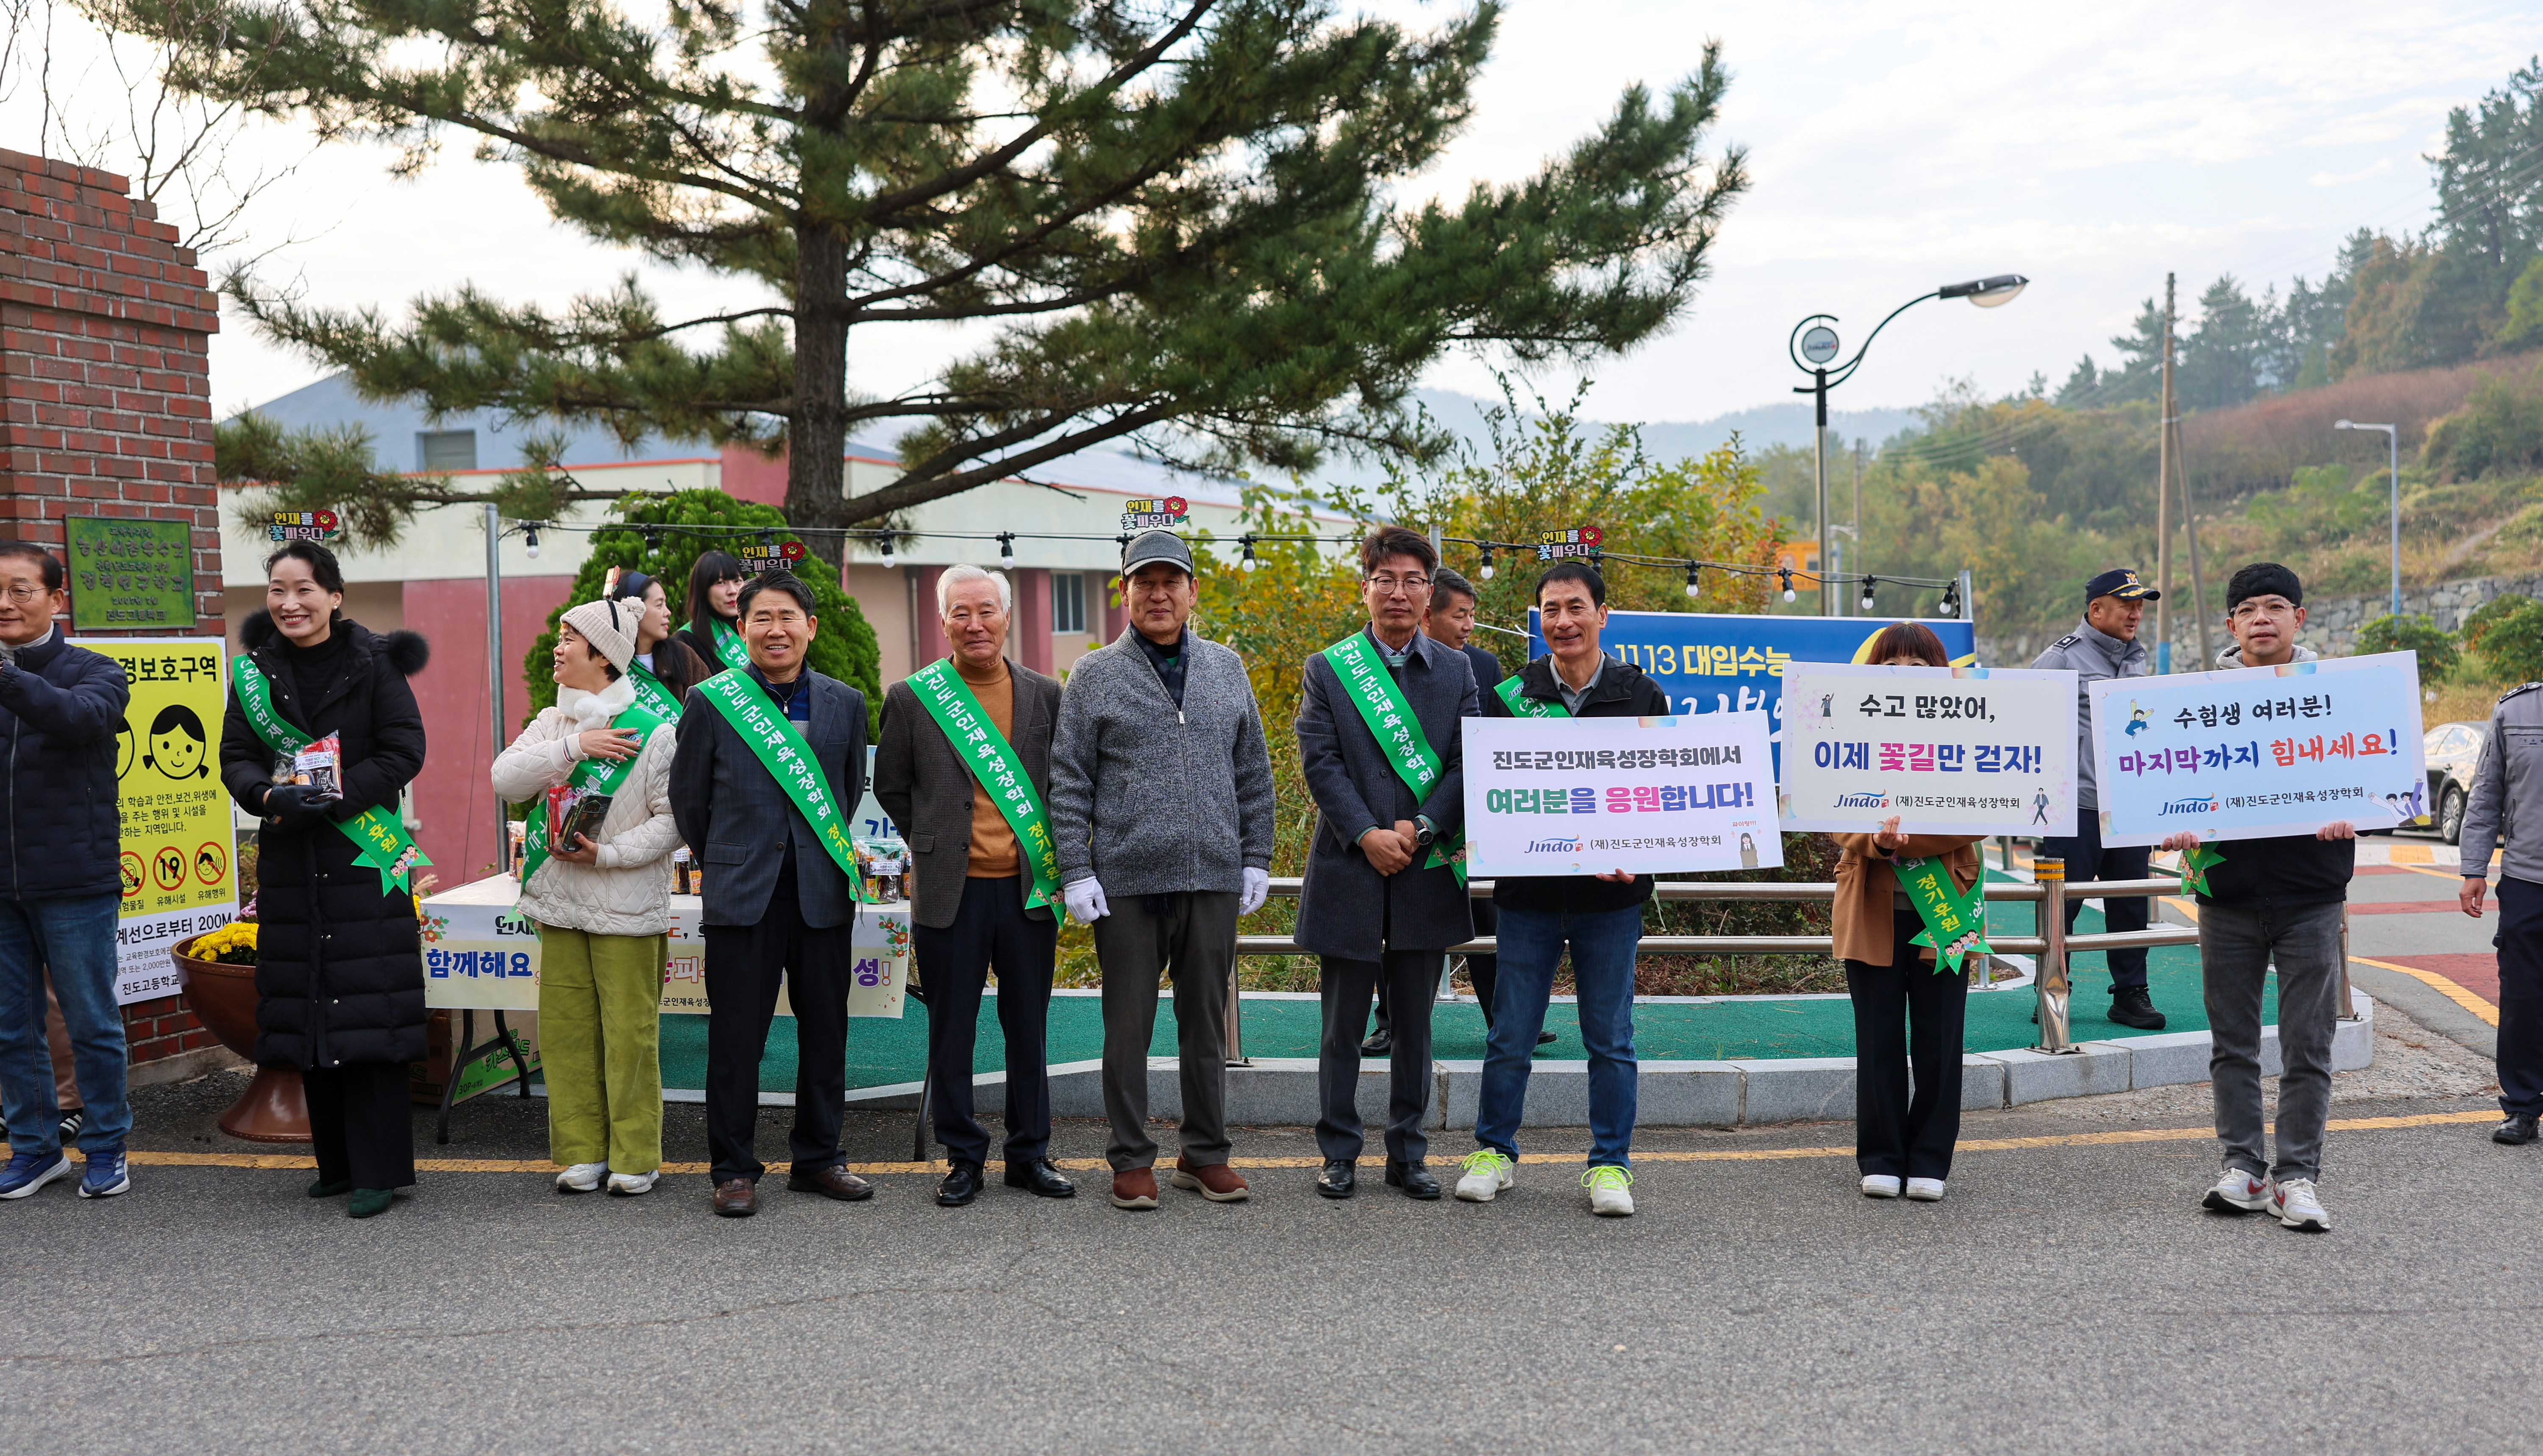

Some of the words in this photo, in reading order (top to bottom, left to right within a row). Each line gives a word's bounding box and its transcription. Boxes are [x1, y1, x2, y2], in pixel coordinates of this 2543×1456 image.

[1127, 500, 1164, 513] 인재를
[274, 512, 313, 525] 인재를
[1122, 514, 1174, 529] 꽃피우다
[270, 525, 324, 541] 꽃피우다
[1542, 530, 1579, 544] 인재를
[743, 545, 781, 559] 인재를
[1537, 544, 1589, 560] 꽃피우다
[739, 558, 792, 572] 꽃피우다
[81, 572, 184, 592] 정책연구학교
[107, 609, 166, 621] 진도고등학교
[1683, 645, 1792, 677] 대입수능
[1333, 640, 1435, 785] (재)진도군인재육성장학회
[1859, 695, 1906, 717] 수고
[1915, 696, 1995, 723] 많았어,
[2173, 702, 2240, 729] 수험생
[2252, 694, 2332, 722] 여러분!
[708, 673, 831, 820] (재)진도군인재육성장학회
[915, 665, 1034, 818] (재)진도군인재육성장학회
[1493, 746, 1741, 770] 진도군인재육성장학회에서
[1814, 742, 1869, 770] 이제
[1878, 742, 1965, 772] 꽃길만
[1974, 745, 2041, 774] 걷자!
[2119, 740, 2260, 778] 마지막까지
[2270, 728, 2397, 767] 힘내세요!
[128, 795, 153, 807] 학습과
[1486, 788, 1597, 814] 여러분을
[1605, 782, 1754, 813] 응원합니다!
[1833, 794, 1880, 809] Jindo
[1895, 795, 2020, 809] (재)진도군인재육성장학회
[2158, 800, 2208, 817] Jindo
[2226, 786, 2364, 809] (재)진도군인재육성장학회
[132, 811, 148, 822] 주는
[153, 808, 169, 820] 행위
[173, 807, 180, 818] 및
[184, 804, 206, 817] 시설을
[145, 821, 186, 836] 지역입니다.
[1525, 839, 1574, 853] Jindo
[1590, 835, 1722, 850] (재)진도군인재육성장학회
[159, 856, 180, 880] 19
[157, 893, 186, 906] 유해시설
[198, 887, 225, 900] 유해행위
[1916, 873, 1961, 932] 정기후원
[198, 912, 232, 931] 200M
[129, 964, 140, 973] 또는
[143, 959, 171, 971] 2,000만원
[426, 948, 533, 978] 함께해요
